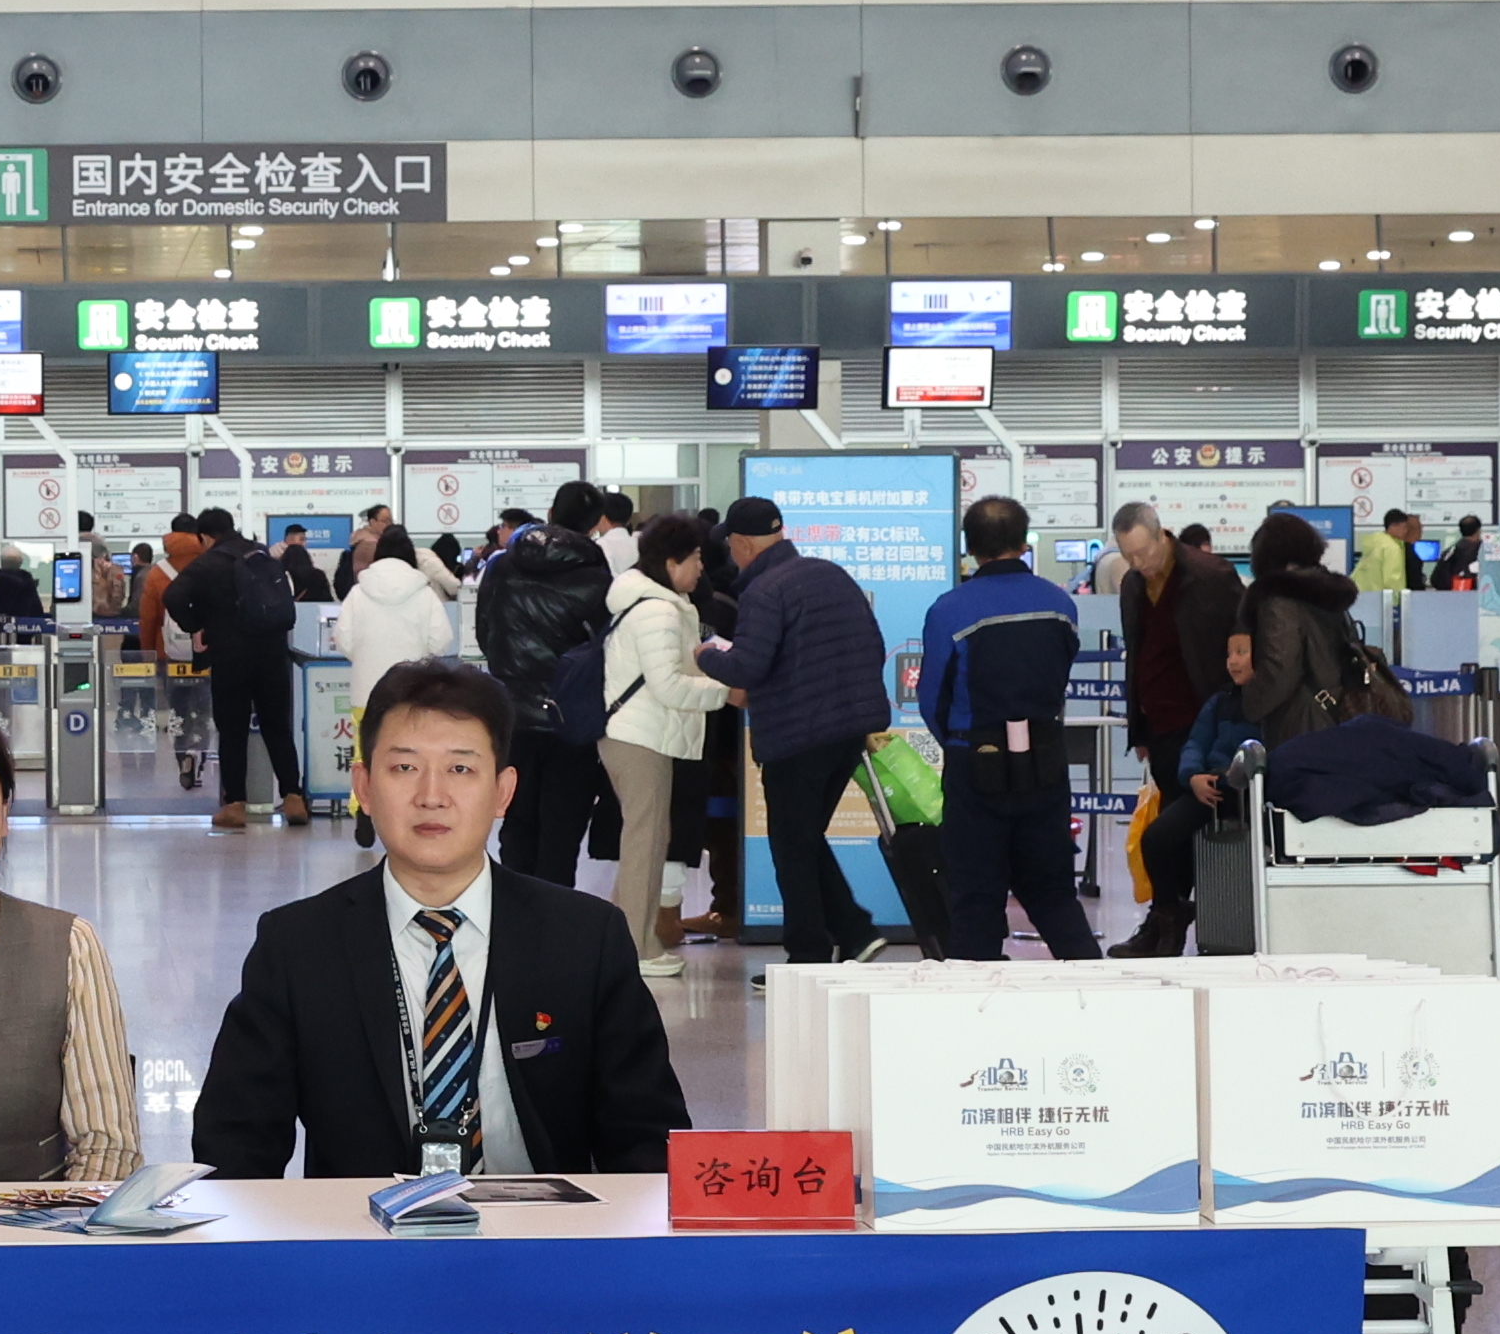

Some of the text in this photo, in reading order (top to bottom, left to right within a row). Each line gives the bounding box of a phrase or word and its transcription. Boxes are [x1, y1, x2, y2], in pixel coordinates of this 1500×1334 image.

[72, 151, 431, 196] 国内安全检查入口
[72, 197, 400, 220] Entrance for Domestic Security Check
[132, 297, 259, 331] 安全检查
[425, 295, 551, 329] 安全检查
[1123, 288, 1246, 321] 安全检查
[134, 331, 260, 354] Security Check
[425, 329, 551, 352] Security Check
[1123, 322, 1247, 344] Security Check
[1413, 321, 1484, 342] Security
[1074, 680, 1126, 699] HLJA
[1417, 676, 1462, 696] HLJA
[692, 1152, 830, 1200] 咨询台
